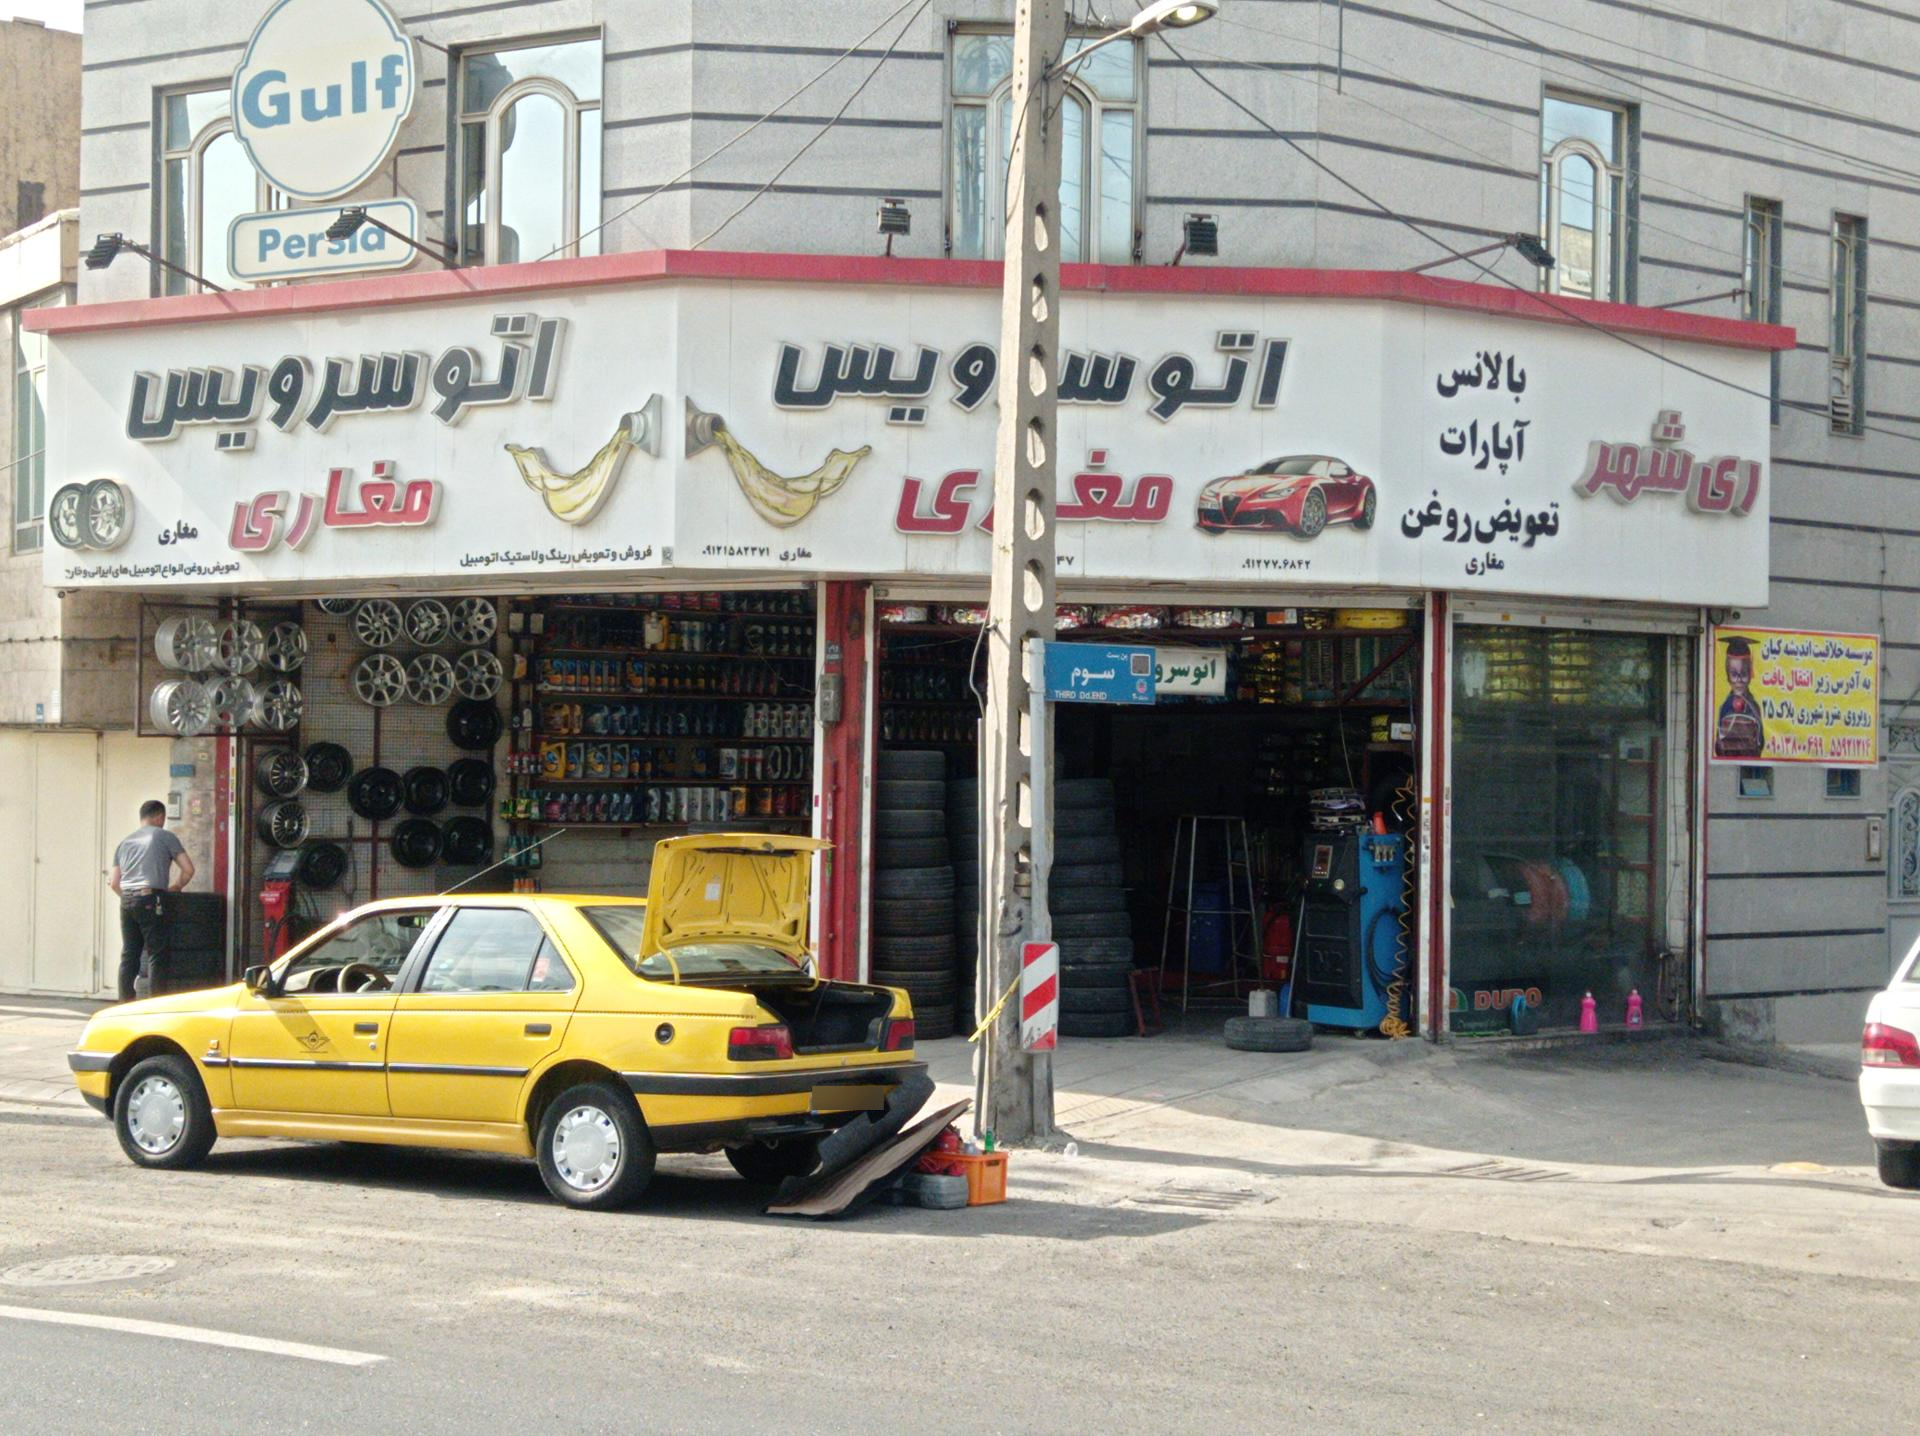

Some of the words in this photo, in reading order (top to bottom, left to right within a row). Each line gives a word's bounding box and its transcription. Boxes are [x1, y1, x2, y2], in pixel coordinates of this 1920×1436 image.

[242, 54, 404, 129] Gulf
[772, 330, 1292, 426] اتوسویس
[1437, 351, 1527, 403] بالانس
[1439, 418, 1531, 476] آپارات
[1573, 409, 1695, 504] شهر
[895, 449, 1175, 536] مغی
[1688, 455, 1763, 517] ری
[230, 458, 440, 553] مغاری
[1401, 489, 1474, 543] روغن
[158, 520, 198, 545] مغاری
[1474, 498, 1559, 548] تعویض
[459, 552, 499, 567] اتومبیل
[500, 549, 538, 565] لاستیک
[545, 548, 572, 564] رینگ
[572, 548, 611, 564] تعویض
[611, 550, 617, 561] و
[619, 545, 653, 561] فروش
[779, 547, 812, 561] مغاری
[1465, 551, 1505, 576] مغاری
[88, 565, 112, 578] ایرانی
[111, 564, 129, 578] های
[129, 563, 161, 577] اتومبیل
[161, 563, 184, 579] انواع
[184, 562, 208, 576] روغن
[208, 561, 240, 575] تعویض
[1813, 640, 1845, 663] خلاقیت
[1845, 647, 1873, 666] موسسه
[1071, 667, 1115, 687] سوم
[1155, 656, 1217, 685] اتوسرو
[1762, 667, 1785, 690] یافت
[1787, 669, 1814, 692] انتقال
[1814, 674, 1830, 694] زیر
[1831, 670, 1860, 695] آدرس
[1862, 677, 1872, 694] به
[1054, 689, 1076, 699] THIRD
[1776, 701, 1795, 725] پلاک
